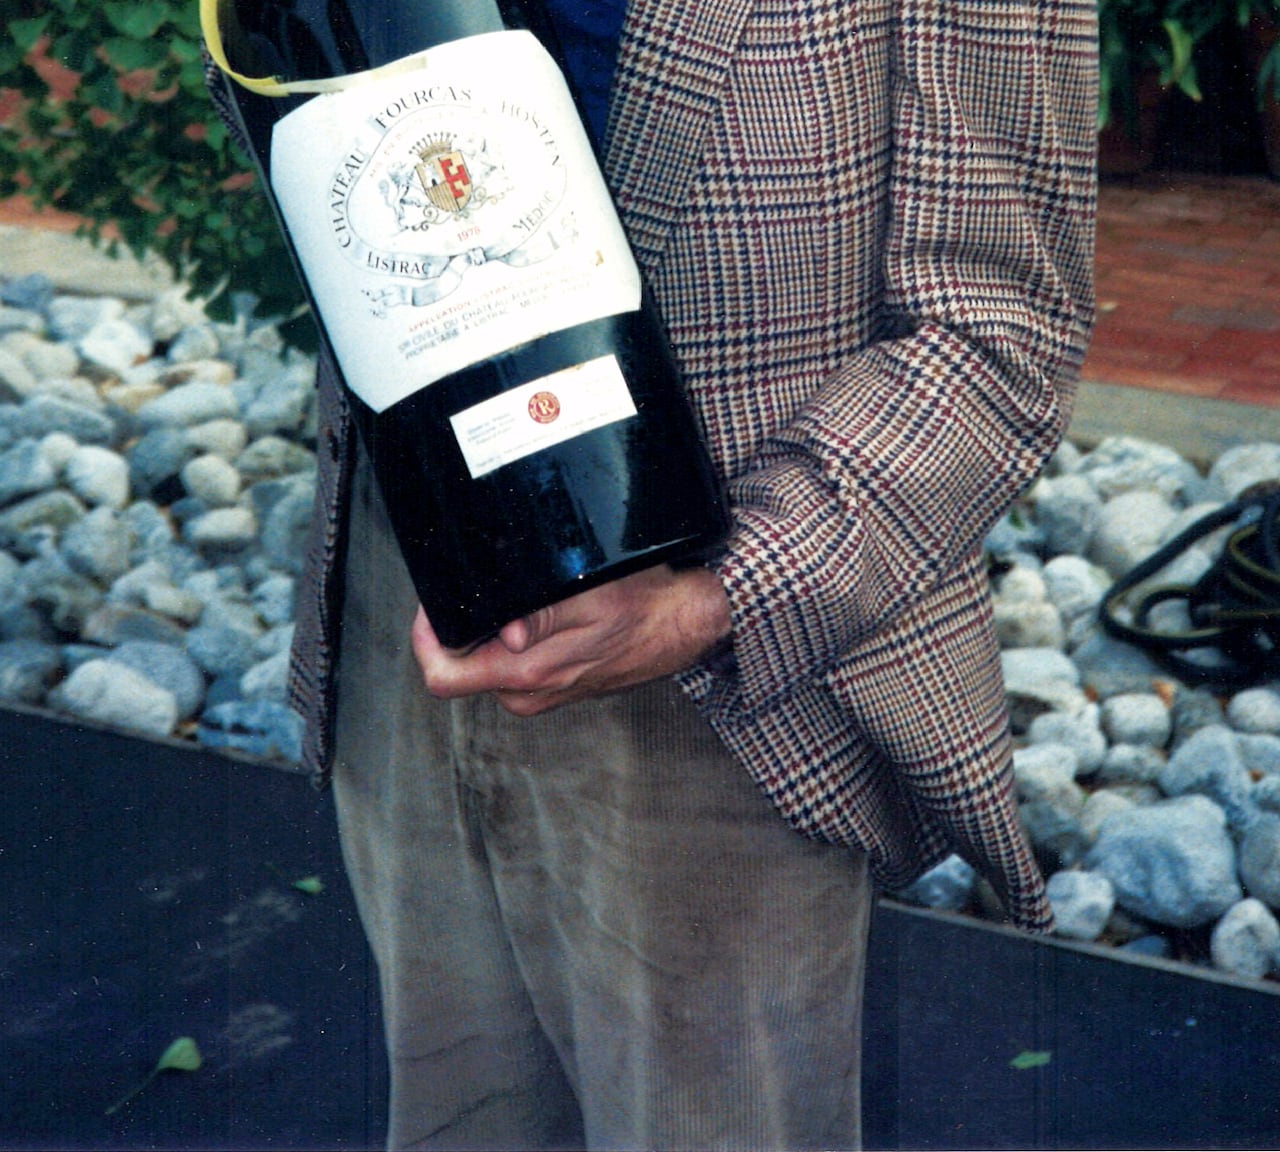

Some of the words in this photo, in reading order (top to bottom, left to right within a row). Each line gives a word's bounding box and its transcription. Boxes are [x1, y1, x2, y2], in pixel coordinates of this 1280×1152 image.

[375, 86, 471, 129] FOURCAS
[501, 100, 561, 166] HOSTEN
[457, 226, 481, 242] 1978
[366, 251, 432, 275] LISTRAC
